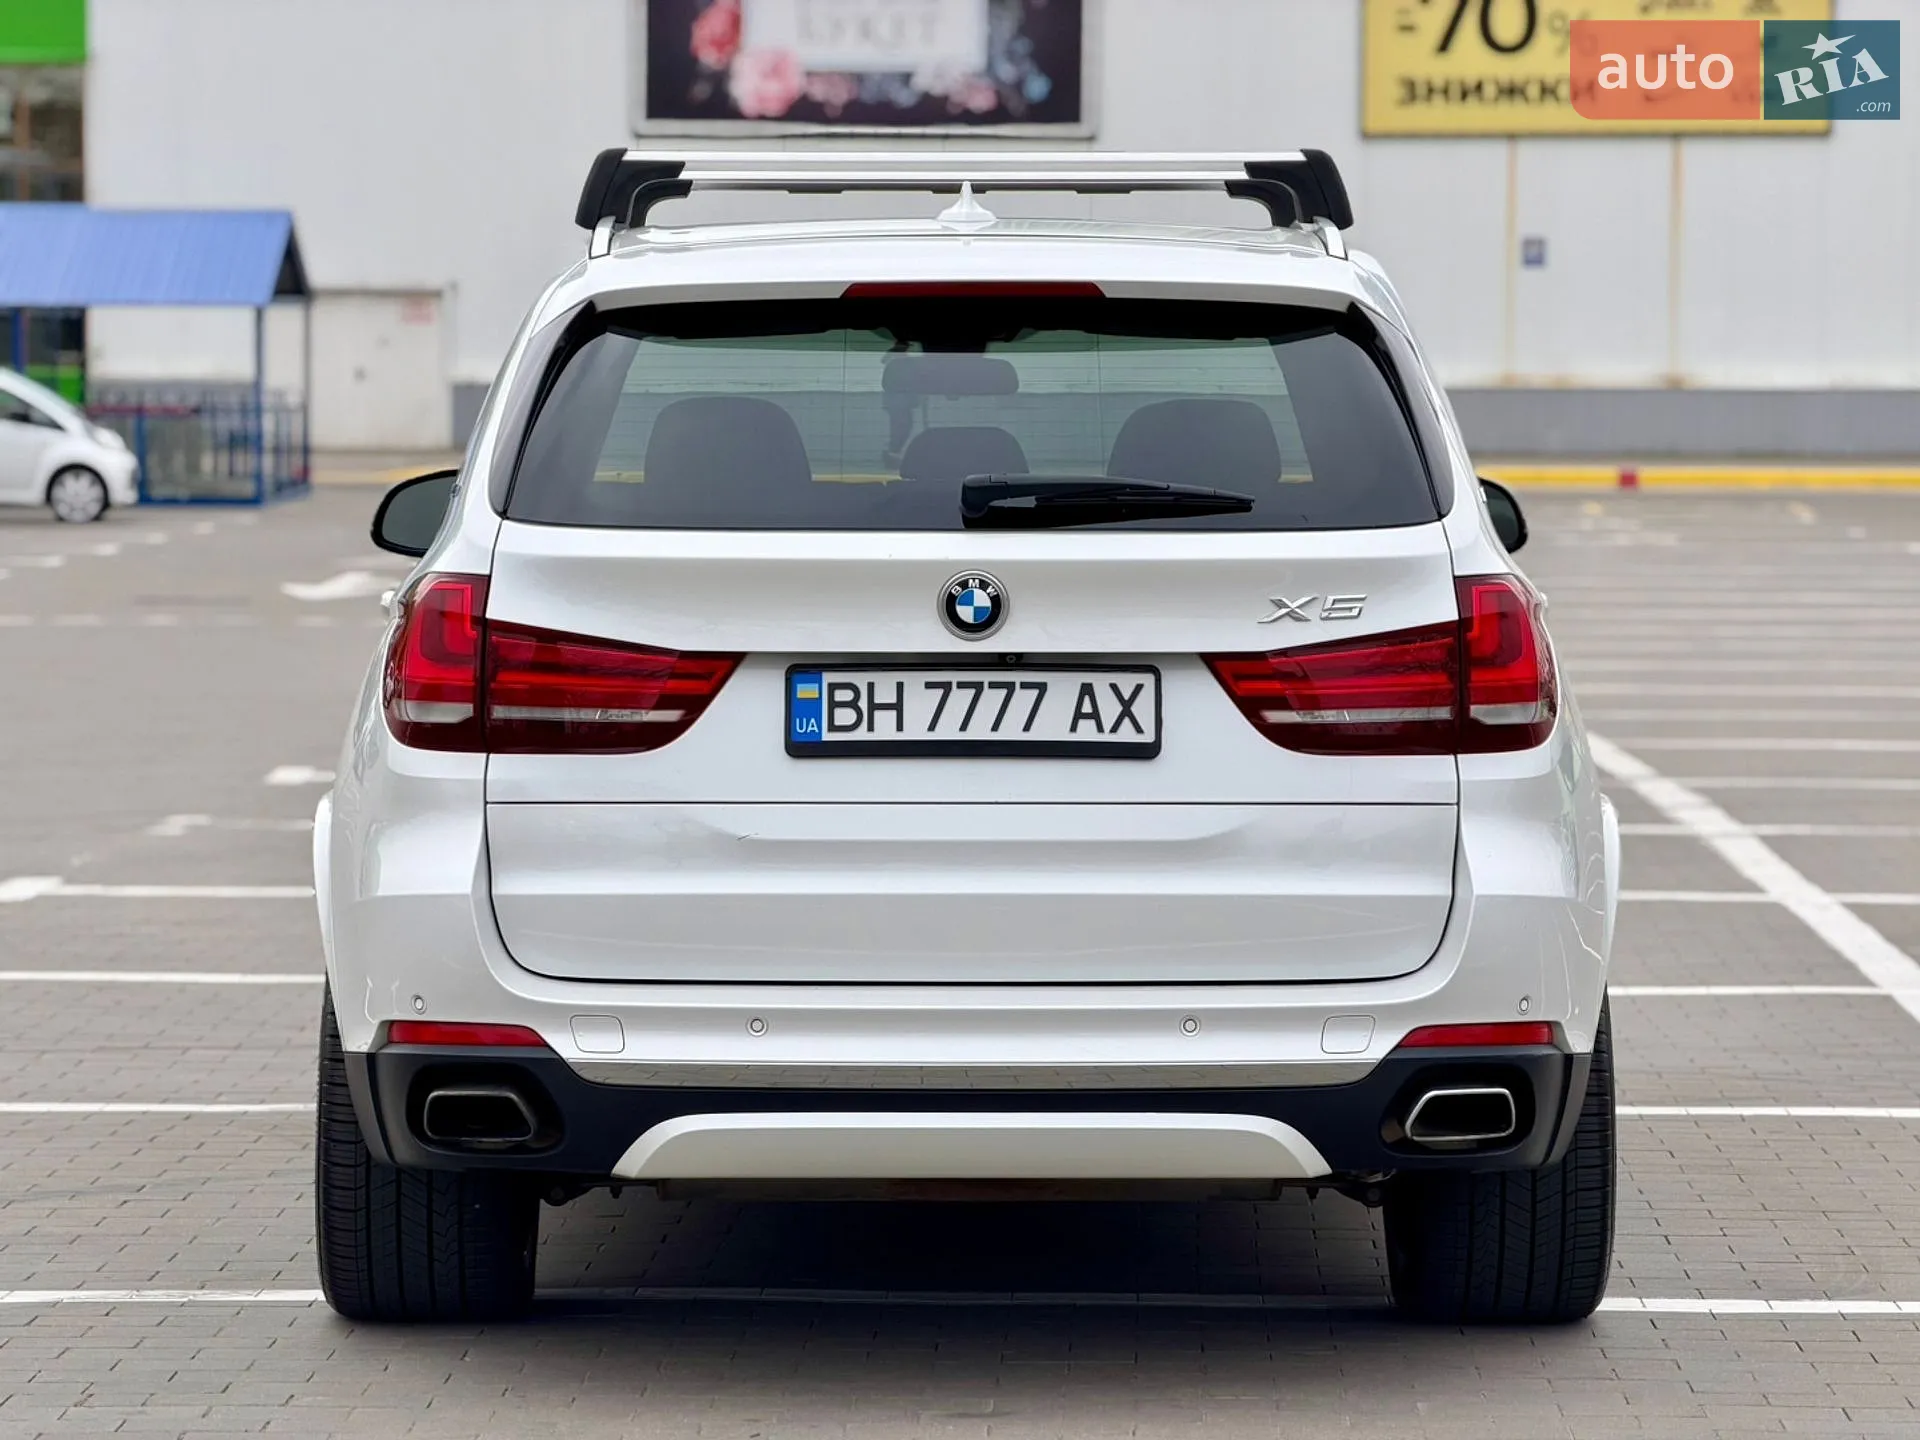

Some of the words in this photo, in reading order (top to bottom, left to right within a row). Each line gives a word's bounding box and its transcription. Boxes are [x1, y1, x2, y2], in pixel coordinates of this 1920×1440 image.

[950, 578, 999, 598] BMW
[1256, 593, 1368, 624] X5
[826, 681, 905, 733] BH
[924, 681, 1049, 733] 7777
[1068, 682, 1145, 735] AX
[795, 717, 820, 734] UA
